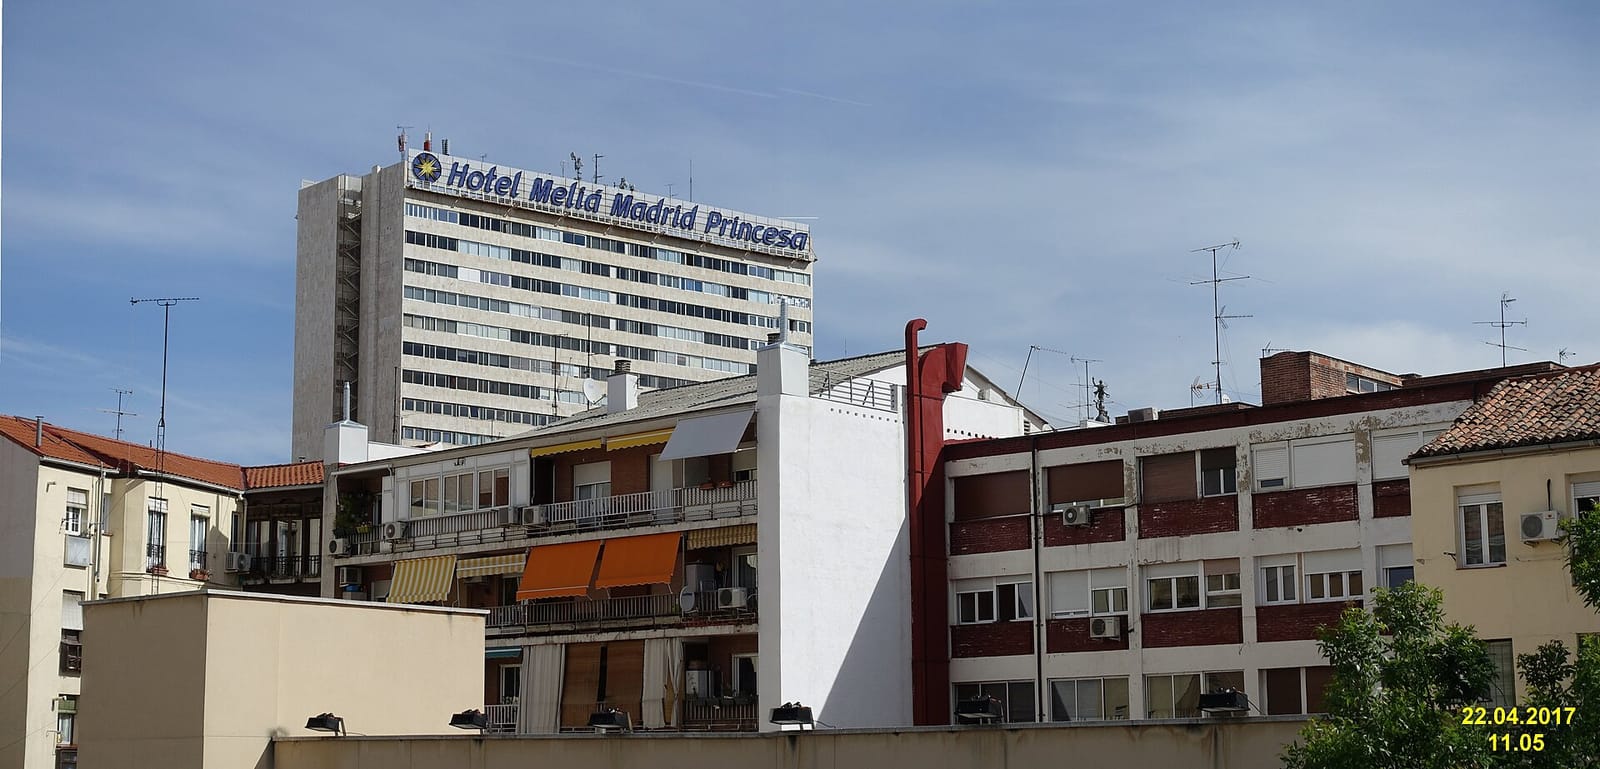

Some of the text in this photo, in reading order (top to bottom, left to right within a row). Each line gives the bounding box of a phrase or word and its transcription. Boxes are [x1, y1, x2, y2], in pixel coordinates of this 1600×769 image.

[447, 162, 808, 251] Hotel Meliá Madrid Princesa
